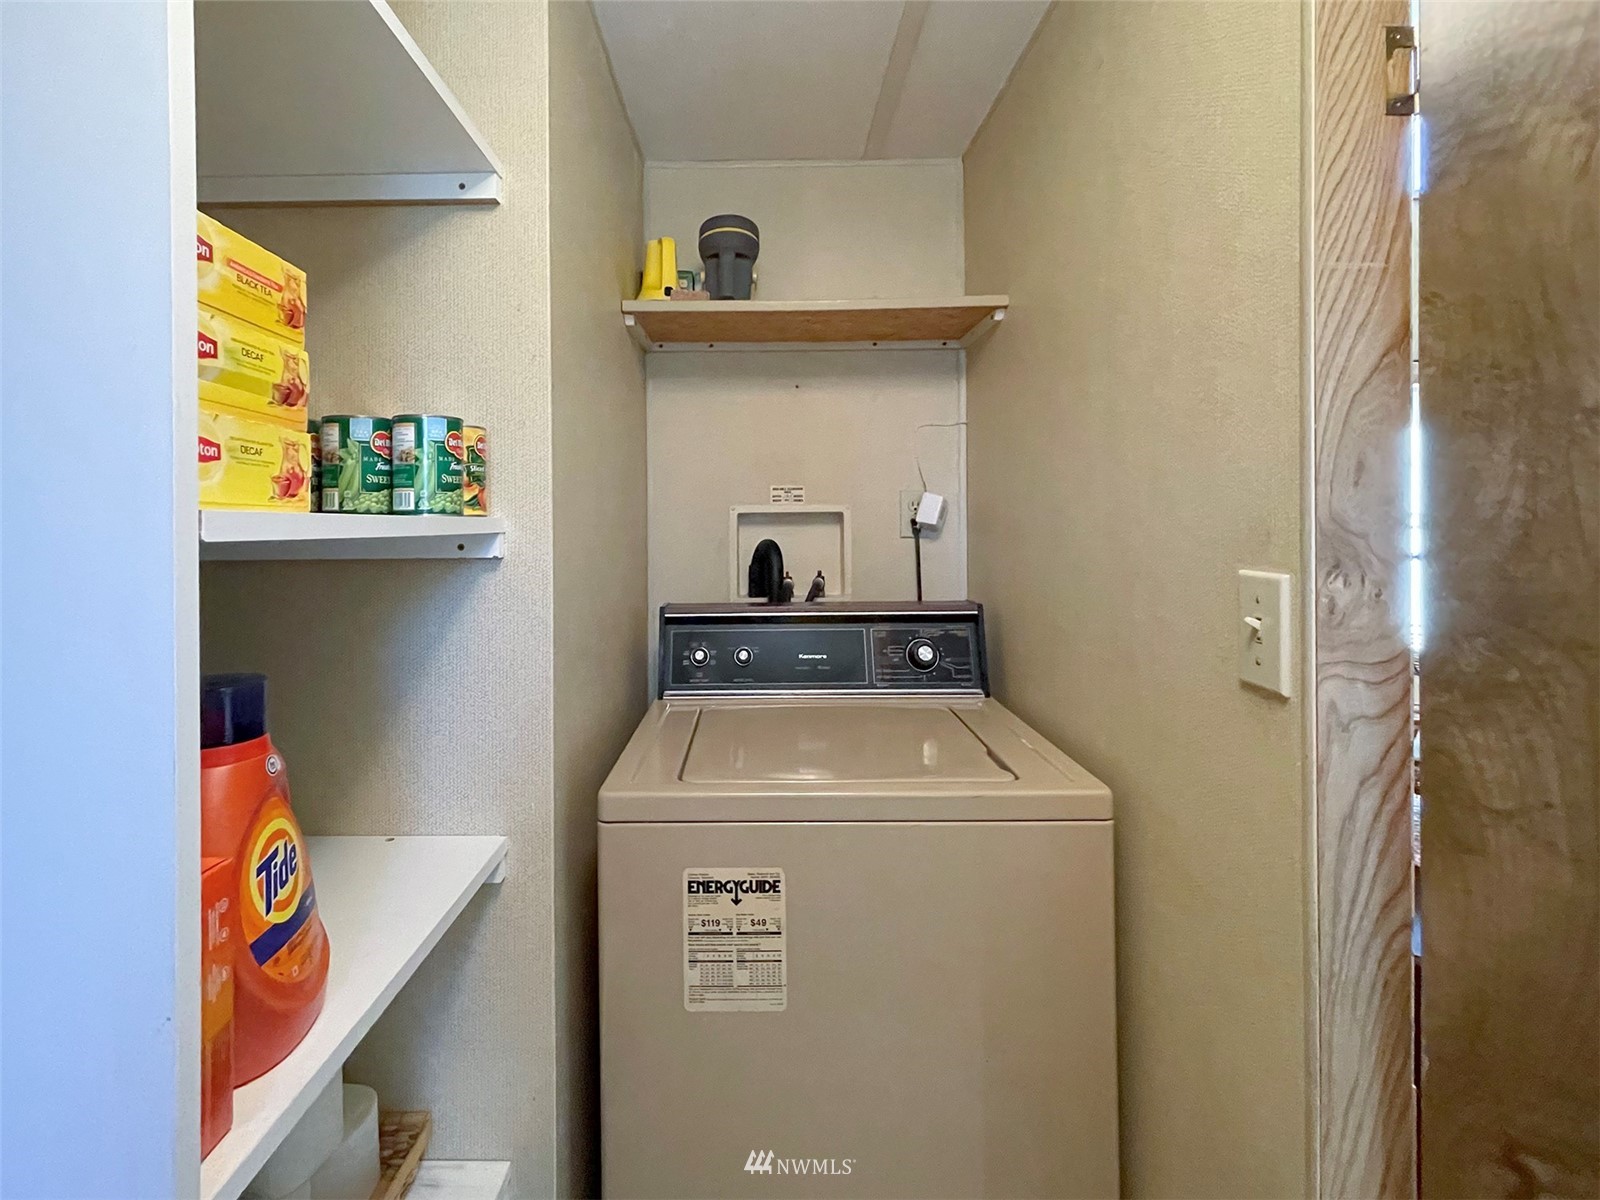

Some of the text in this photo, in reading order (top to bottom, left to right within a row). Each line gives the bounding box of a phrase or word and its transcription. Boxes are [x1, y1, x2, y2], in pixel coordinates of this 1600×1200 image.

[197, 242, 210, 258] on
[236, 273, 258, 291] BLACK
[260, 285, 273, 298] TEA
[198, 340, 215, 354] on
[241, 347, 264, 362] DECAF
[199, 444, 218, 457] ton
[240, 445, 263, 457] DECAF
[255, 837, 298, 920] Tide
[700, 918, 721, 928] $119
[750, 918, 767, 927] $49
